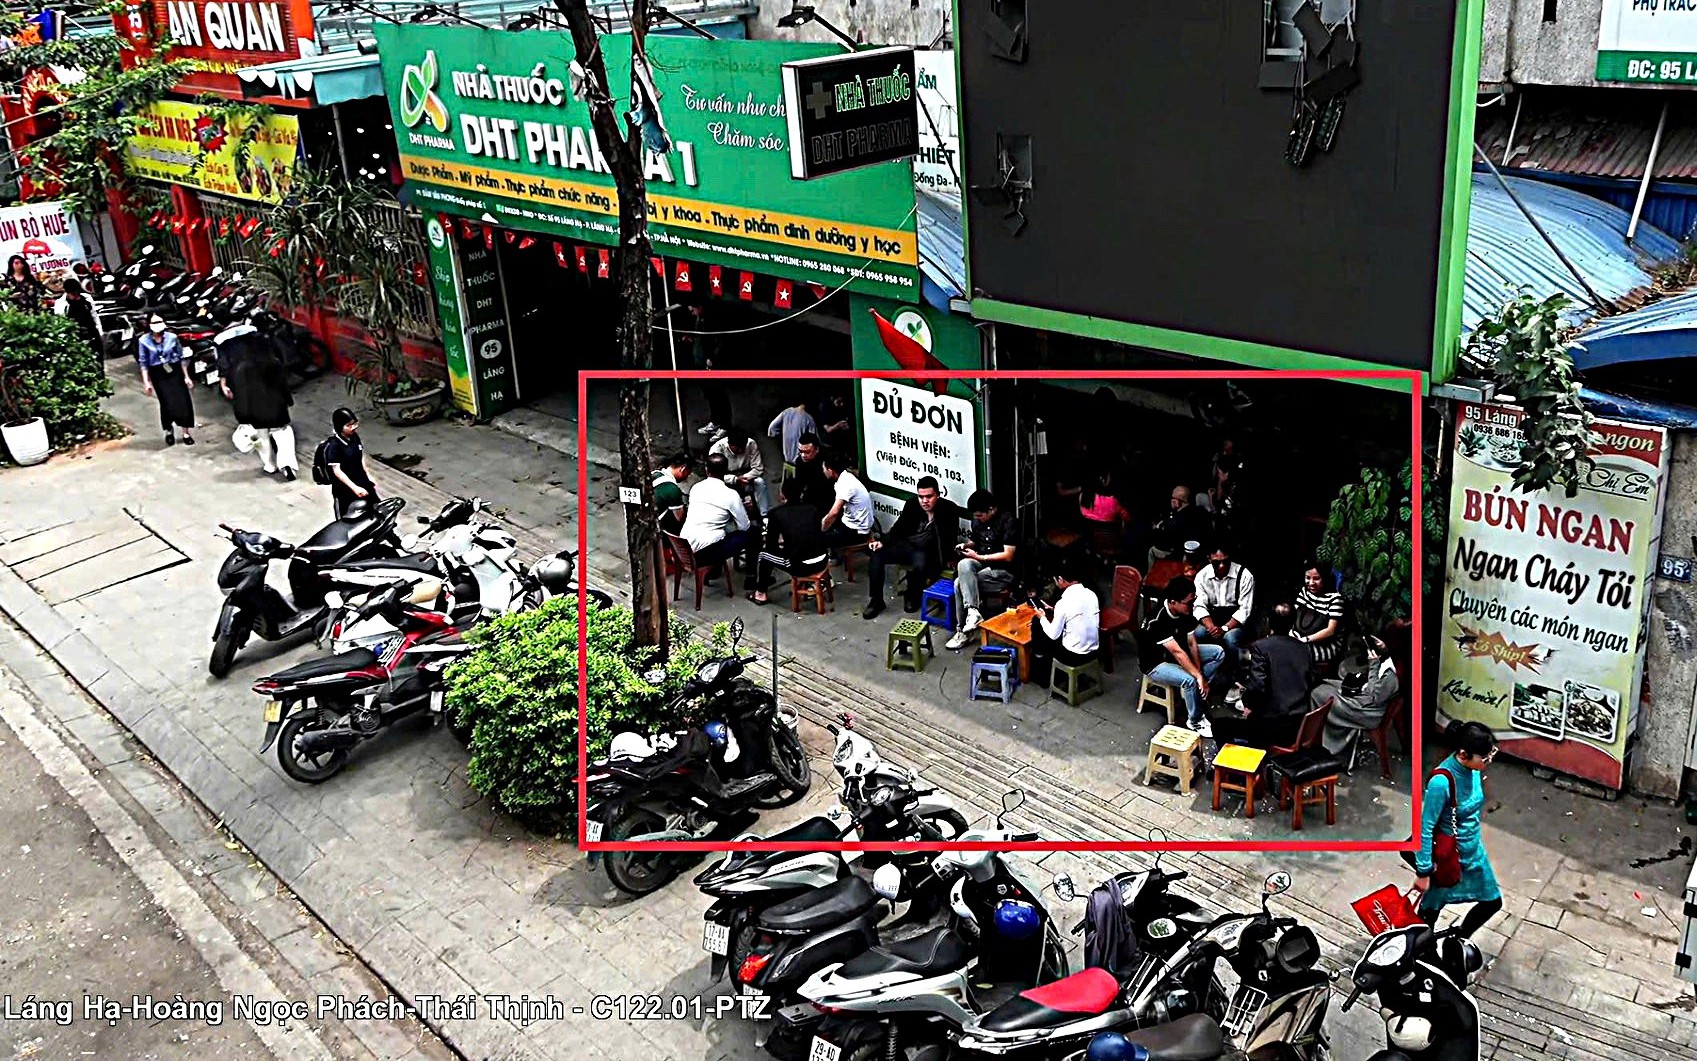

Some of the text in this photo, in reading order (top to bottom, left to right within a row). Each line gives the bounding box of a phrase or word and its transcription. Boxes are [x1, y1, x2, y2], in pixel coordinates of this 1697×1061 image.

[204, 2, 285, 51] QUAN
[451, 62, 565, 106] NHÀ THUỐC
[1628, 60, 1697, 80] ĐC: 95 L
[681, 84, 706, 110] Tư
[708, 92, 734, 113] vấn
[737, 92, 766, 116] như
[834, 63, 911, 113] NHÀ THUỐC
[459, 113, 520, 161] DHT
[676, 140, 698, 186] 1
[707, 122, 784, 150] Chăm sóc
[811, 118, 912, 165] DHT PHARMA
[410, 162, 430, 178] Dược
[431, 163, 454, 181] Phẩm
[459, 170, 472, 186] Mỹ
[475, 171, 500, 189] phẩm
[505, 178, 526, 195] Thực
[529, 180, 555, 198] phẩm
[558, 188, 581, 202] chức
[585, 192, 610, 211] năng
[662, 206, 668, 220] y
[672, 205, 702, 223] khoa
[711, 211, 740, 231] Thực
[744, 213, 780, 235] phẩm
[815, 227, 856, 252] dưỡng
[860, 237, 869, 253] y
[874, 235, 901, 255] học
[20, 212, 40, 238] BÒ
[41, 208, 70, 236] HUẾ
[865, 270, 883, 281] 0965
[476, 297, 493, 309] DHT
[470, 318, 505, 335] PHARMA
[484, 342, 499, 355] 95
[873, 387, 963, 434] ĐỦ ĐƠN
[1465, 405, 1481, 420] 95
[1485, 409, 1517, 428] Láng
[890, 431, 951, 459] BỆNH VIỆN:
[1606, 432, 1655, 452] ngon
[876, 450, 965, 485] (Việt Đức, 108, 103,
[892, 471, 916, 486] Bạch
[1586, 468, 1650, 495] Chị Em
[624, 490, 637, 498] 123
[873, 501, 901, 516] Hotlin
[1463, 485, 1635, 555] BÚN NGAN
[1453, 537, 1636, 610] Ngan Cháy Tỏi
[1450, 587, 1629, 654] Chuyên các món ngan
[1491, 645, 1525, 662] Ship!
